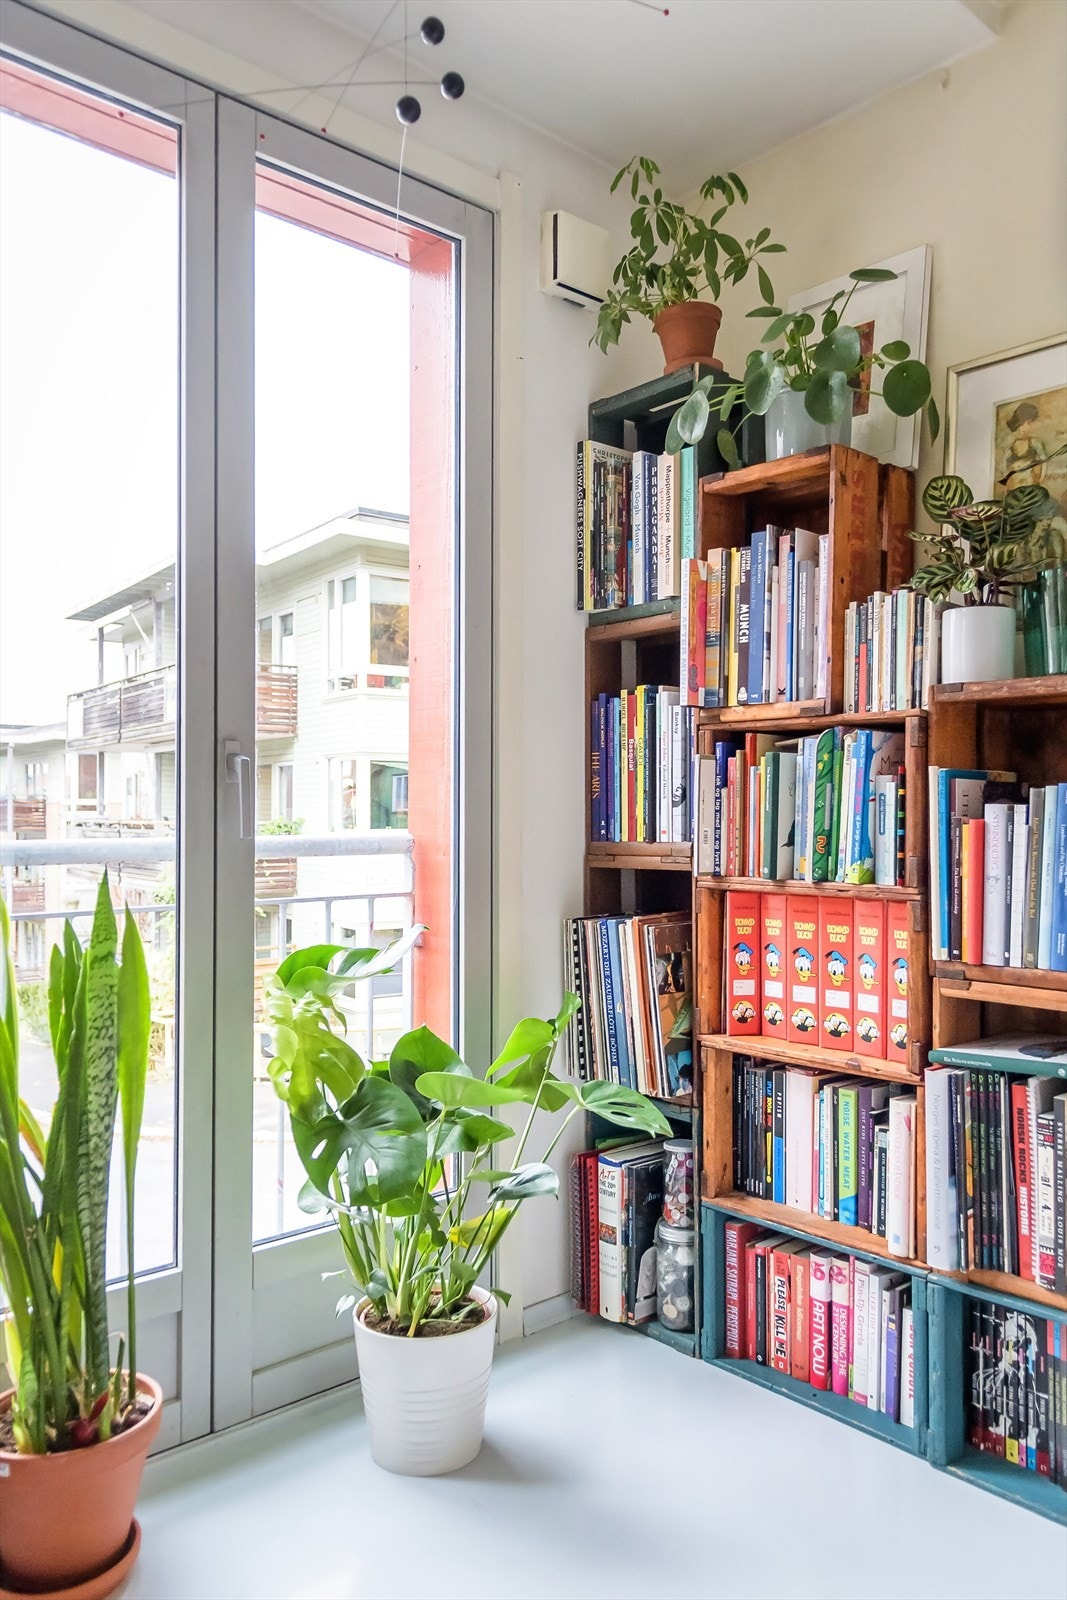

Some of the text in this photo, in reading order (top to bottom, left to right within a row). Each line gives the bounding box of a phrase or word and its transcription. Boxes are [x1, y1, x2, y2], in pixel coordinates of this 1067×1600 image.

[664, 465, 673, 523] Mapplethorpe
[664, 534, 673, 564] Munch
[708, 566, 720, 641] Munch papir
[681, 561, 689, 705] WARHOL AFTER MUNCH
[739, 603, 750, 644] MUNCH
[627, 738, 635, 772] Basquiat
[714, 775, 722, 786] lek
[714, 799, 722, 810] lag
[714, 812, 722, 827] med
[714, 851, 722, 865] lyst
[735, 918, 755, 927] DONALD
[794, 921, 816, 931] DONALD
[796, 930, 813, 940] DUCK
[827, 924, 849, 934] DONALD
[829, 933, 847, 943] DUCK
[859, 926, 879, 937] DONALD
[600, 925, 610, 959] MOZART
[603, 961, 611, 976] DIE
[932, 1093, 942, 1127] Norges
[842, 1100, 851, 1191] NOISE WATER MEAT
[932, 1129, 941, 1156] opera
[1017, 1106, 1030, 1236] NORSK ROCKS HISTORIE
[1057, 1159, 1065, 1203] MALLING
[1057, 1216, 1065, 1244] LOUIS
[726, 1229, 738, 1350] MARJANE SATRAPI PERSEPOLIS
[795, 1264, 804, 1342] Engelske idiomer
[775, 1278, 787, 1357] PLEASE KILL ME
[856, 1278, 866, 1347] Pin-Up Grrrls
[812, 1300, 825, 1376] ART NOW
[831, 1323, 840, 1366] CENTURY
[838, 1307, 848, 1377] DESIGNING THE
